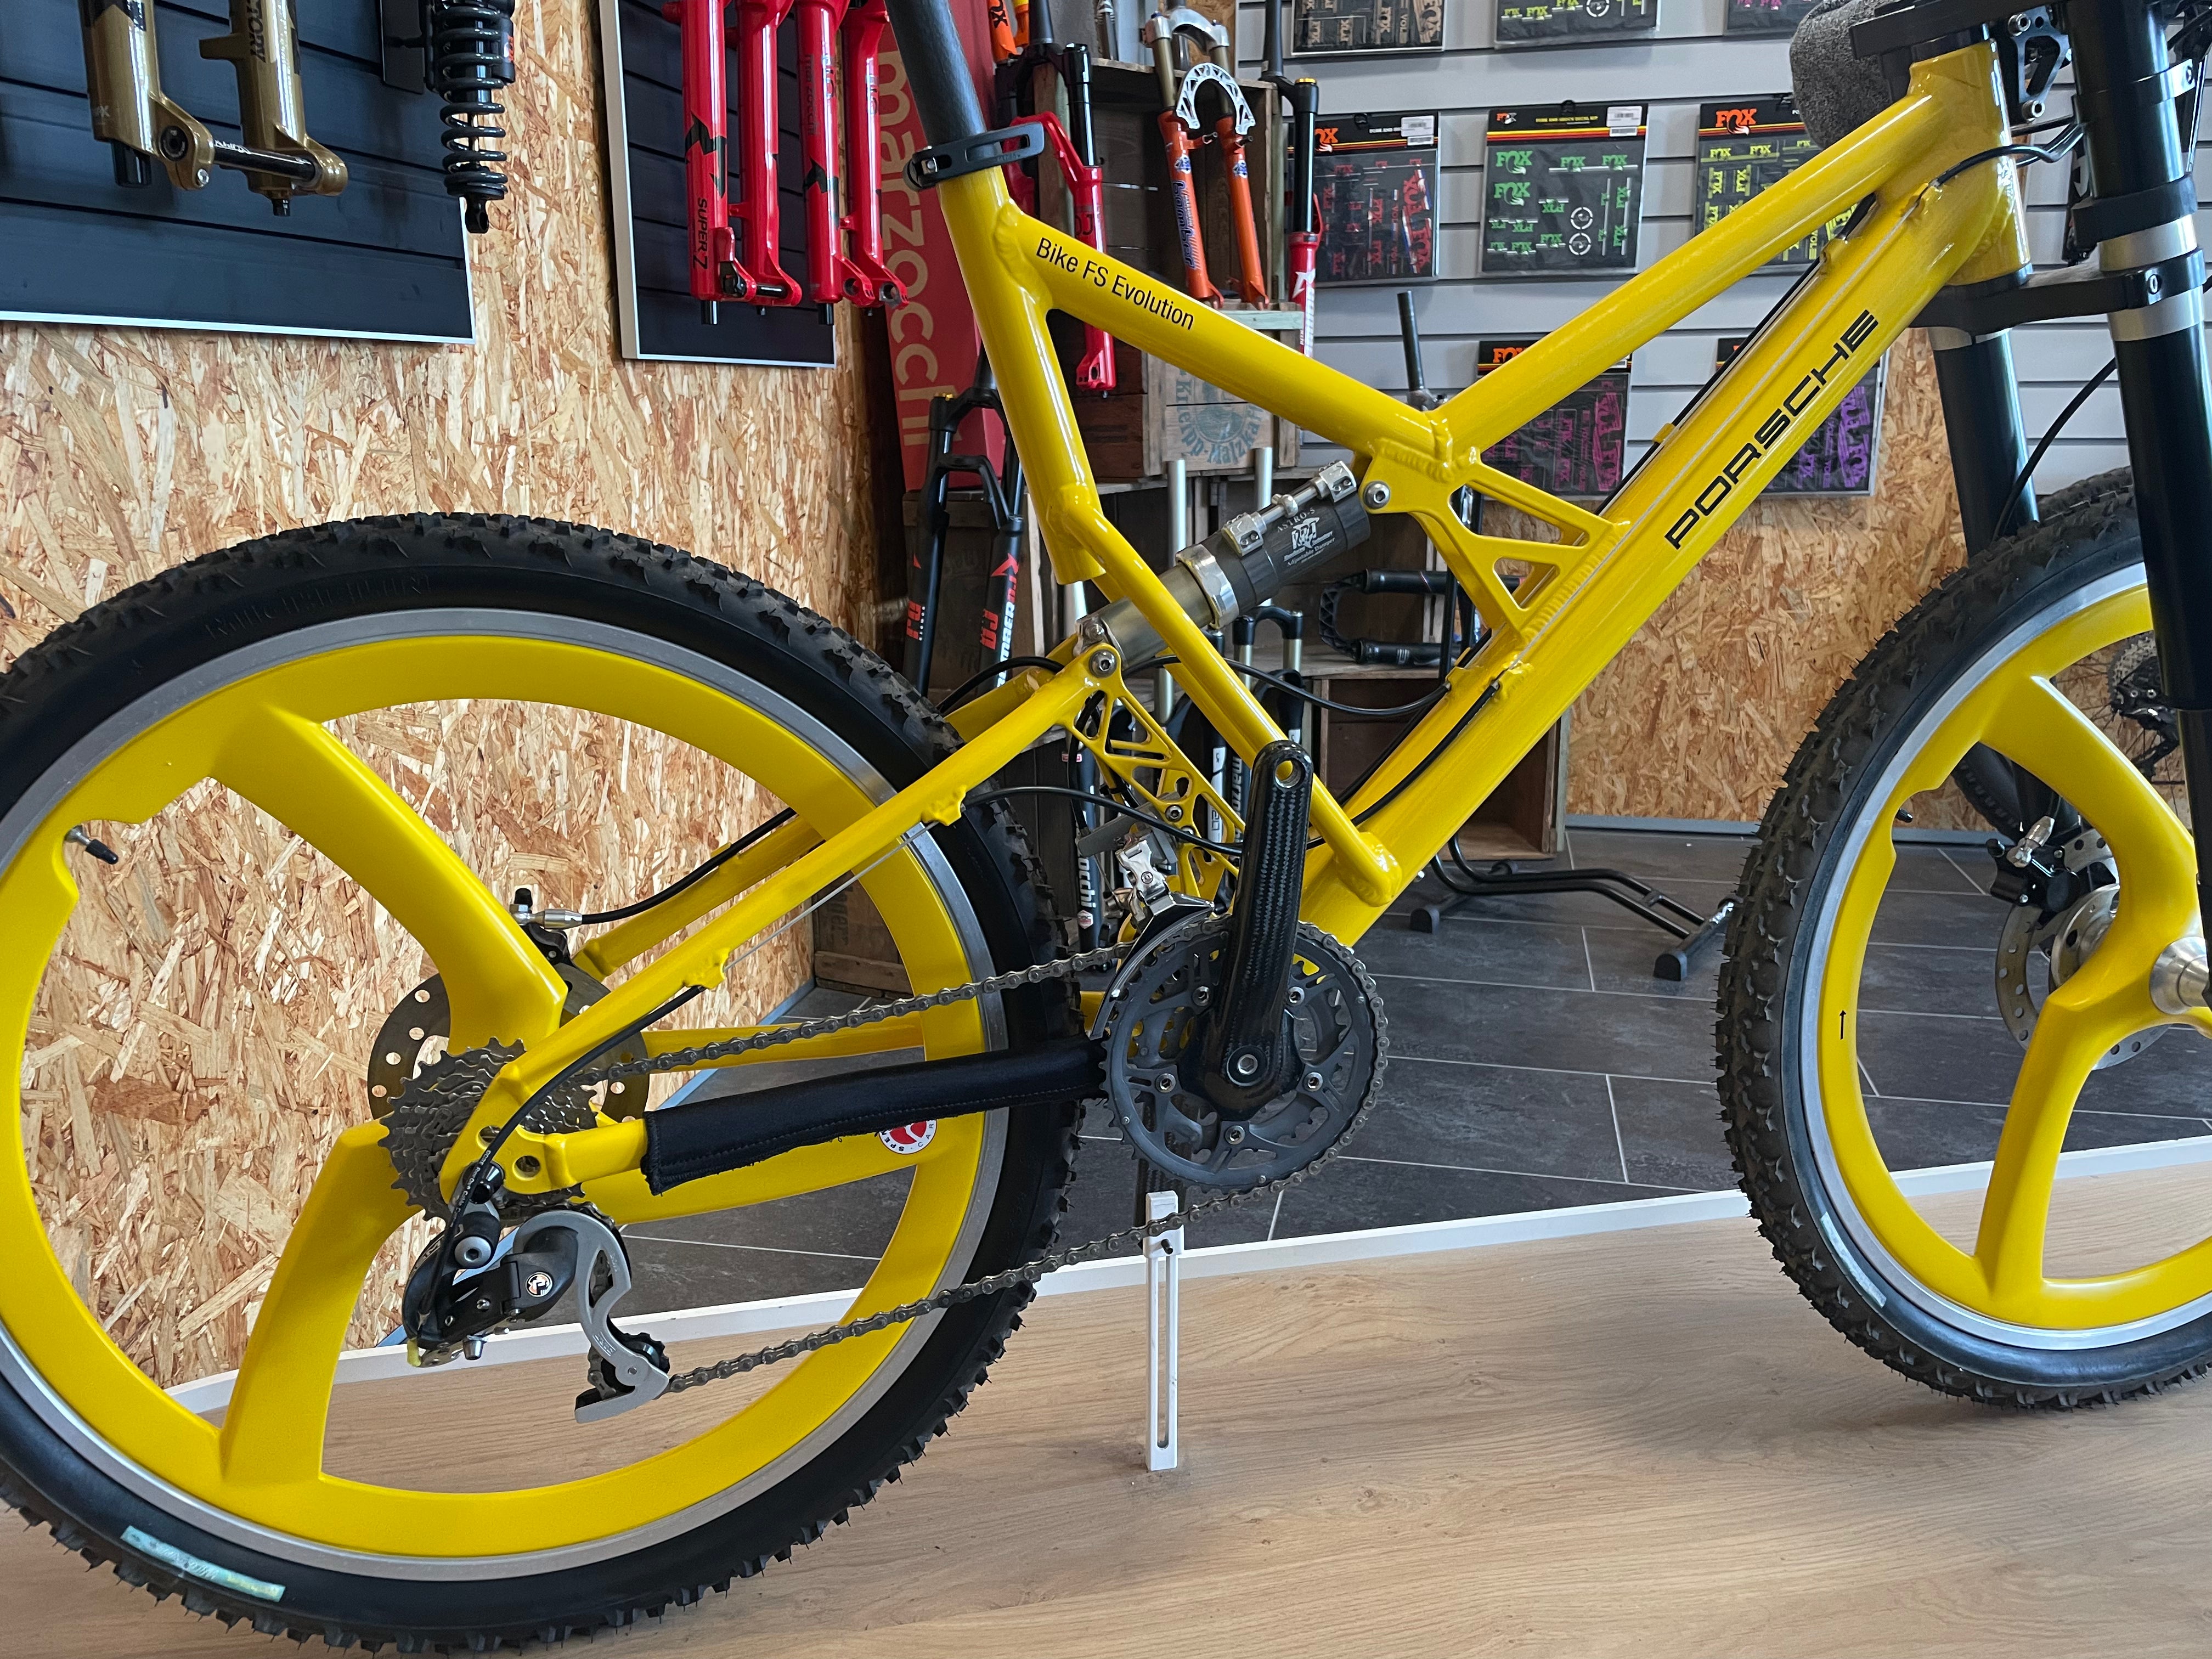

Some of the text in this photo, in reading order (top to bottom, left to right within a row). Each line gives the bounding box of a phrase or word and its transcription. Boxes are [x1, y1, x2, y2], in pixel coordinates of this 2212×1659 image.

[247, 0, 266, 63] TORY
[1716, 109, 1757, 136] FOX
[1314, 127, 1339, 153] OX
[1750, 145, 1771, 157] FOX
[1496, 150, 1533, 175] FOX
[1561, 156, 1586, 172] FOX
[1602, 155, 1628, 171] FOX
[1710, 148, 1731, 161] FOX
[1494, 182, 1531, 206] FOX
[697, 197, 708, 252] SUPER
[1172, 180, 1197, 269] bomber
[1036, 238, 1194, 330] Bike FS Evolution
[1664, 309, 1879, 549] PORSCHE
[1277, 507, 1315, 533] ASTRO-5
[1232, 756, 1244, 843] marzoi
[1077, 857, 1096, 909] occhi
[917, 1124, 934, 1148] CAR
